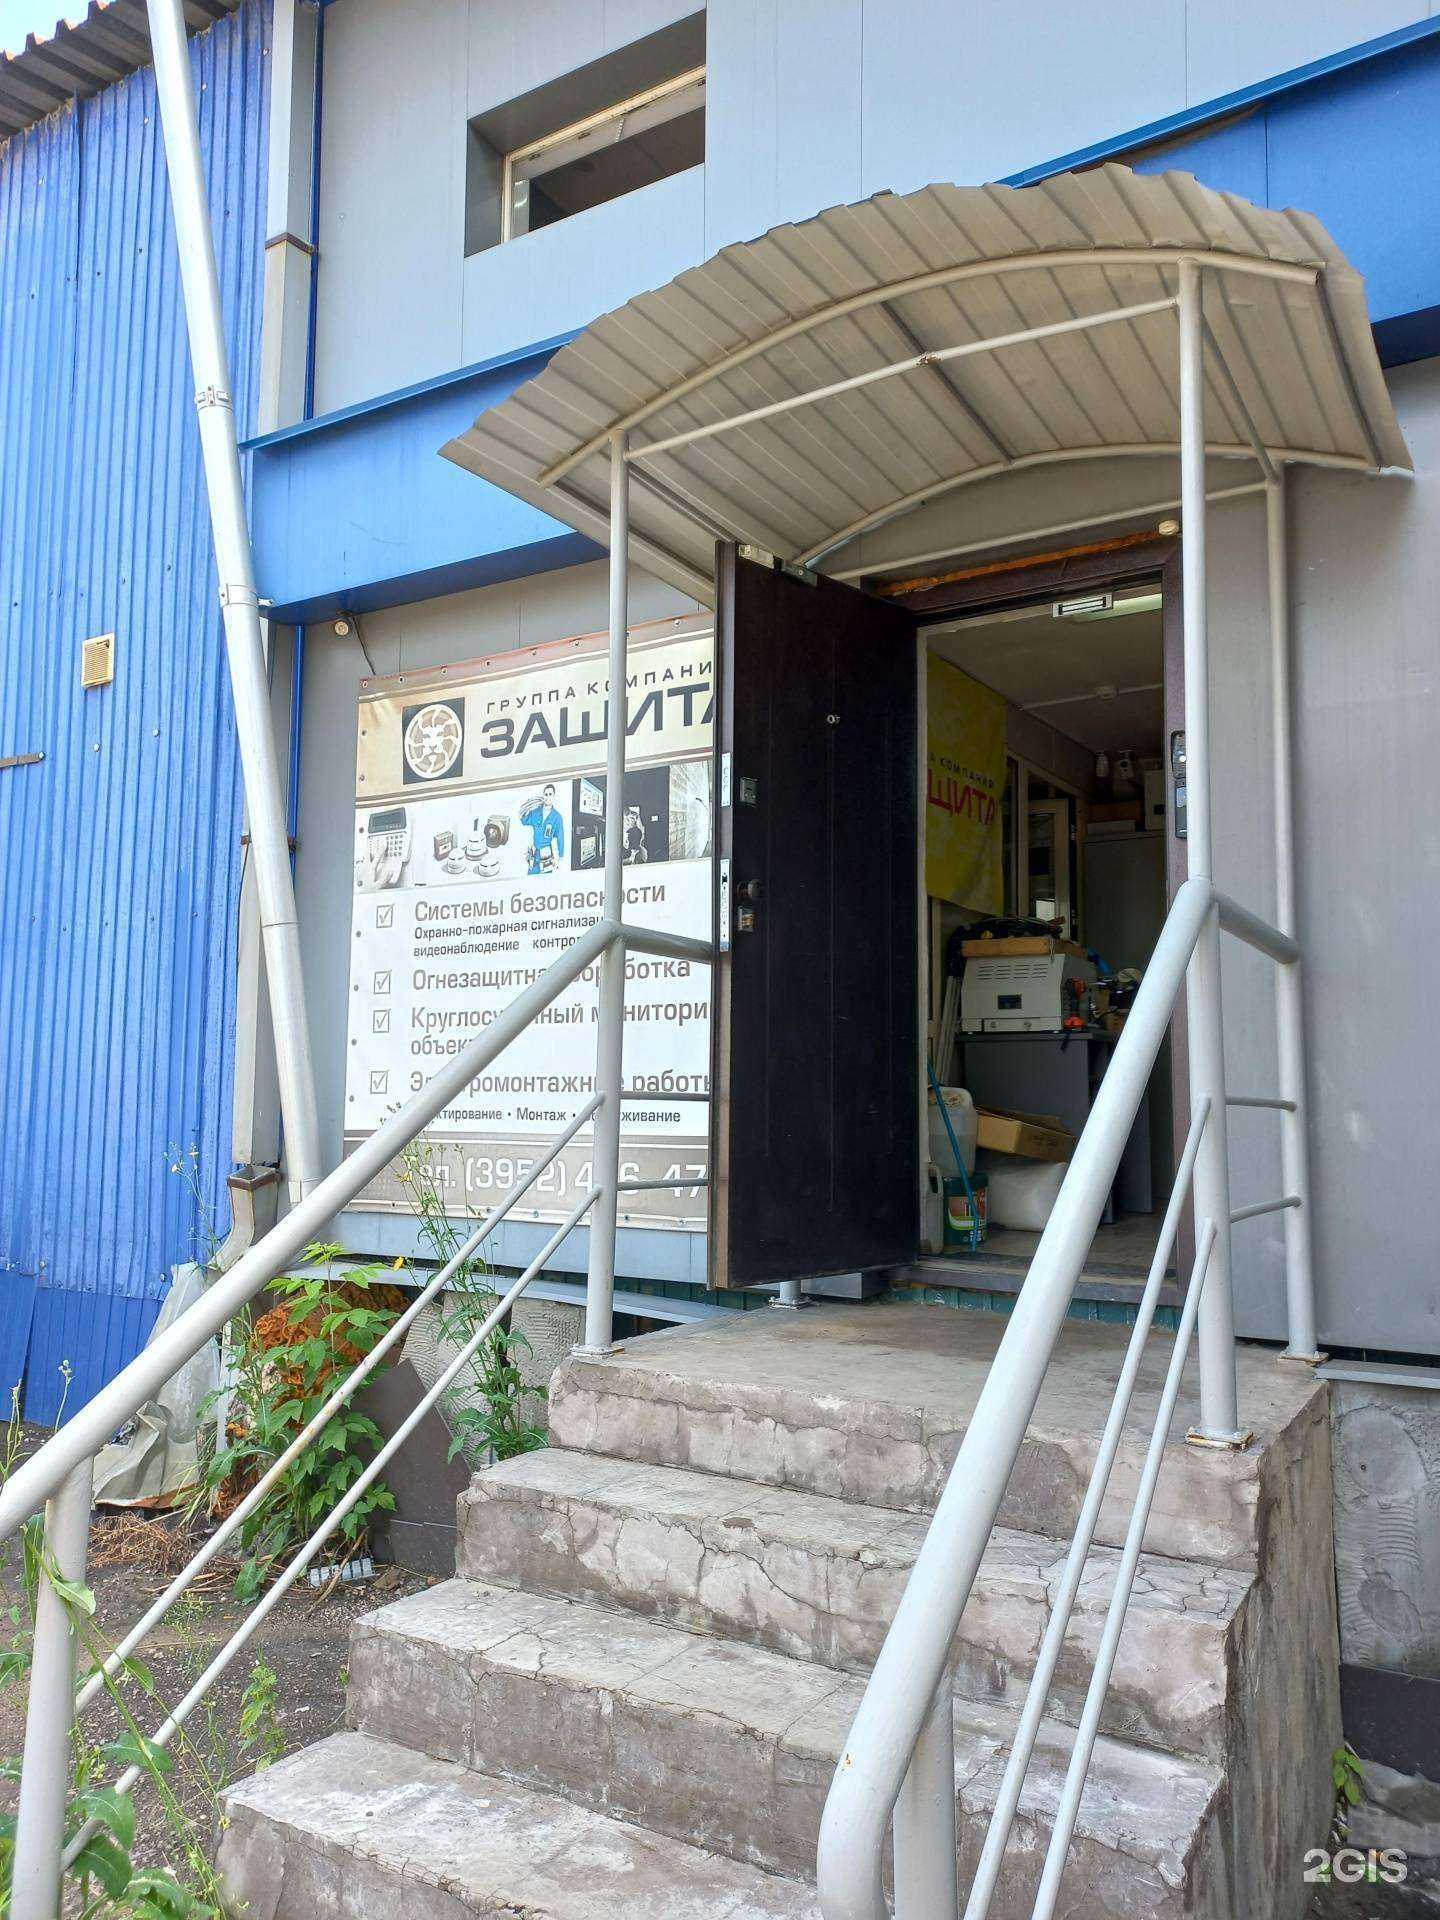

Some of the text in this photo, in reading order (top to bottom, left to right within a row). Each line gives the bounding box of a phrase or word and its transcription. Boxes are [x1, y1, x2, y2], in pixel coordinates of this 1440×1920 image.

[487, 661, 712, 715] ГРУППА КМПАНИ
[928, 768, 996, 826] ЩИТА
[415, 899, 504, 922] Системы
[414, 921, 528, 941] Охранно-пожарная
[413, 936, 581, 958] видеонаблюдение контро
[413, 967, 548, 990] Огнезащитн
[411, 1034, 473, 1056] объек
[516, 1107, 567, 1121] Монтаж
[465, 1156, 566, 1197] (3952)
